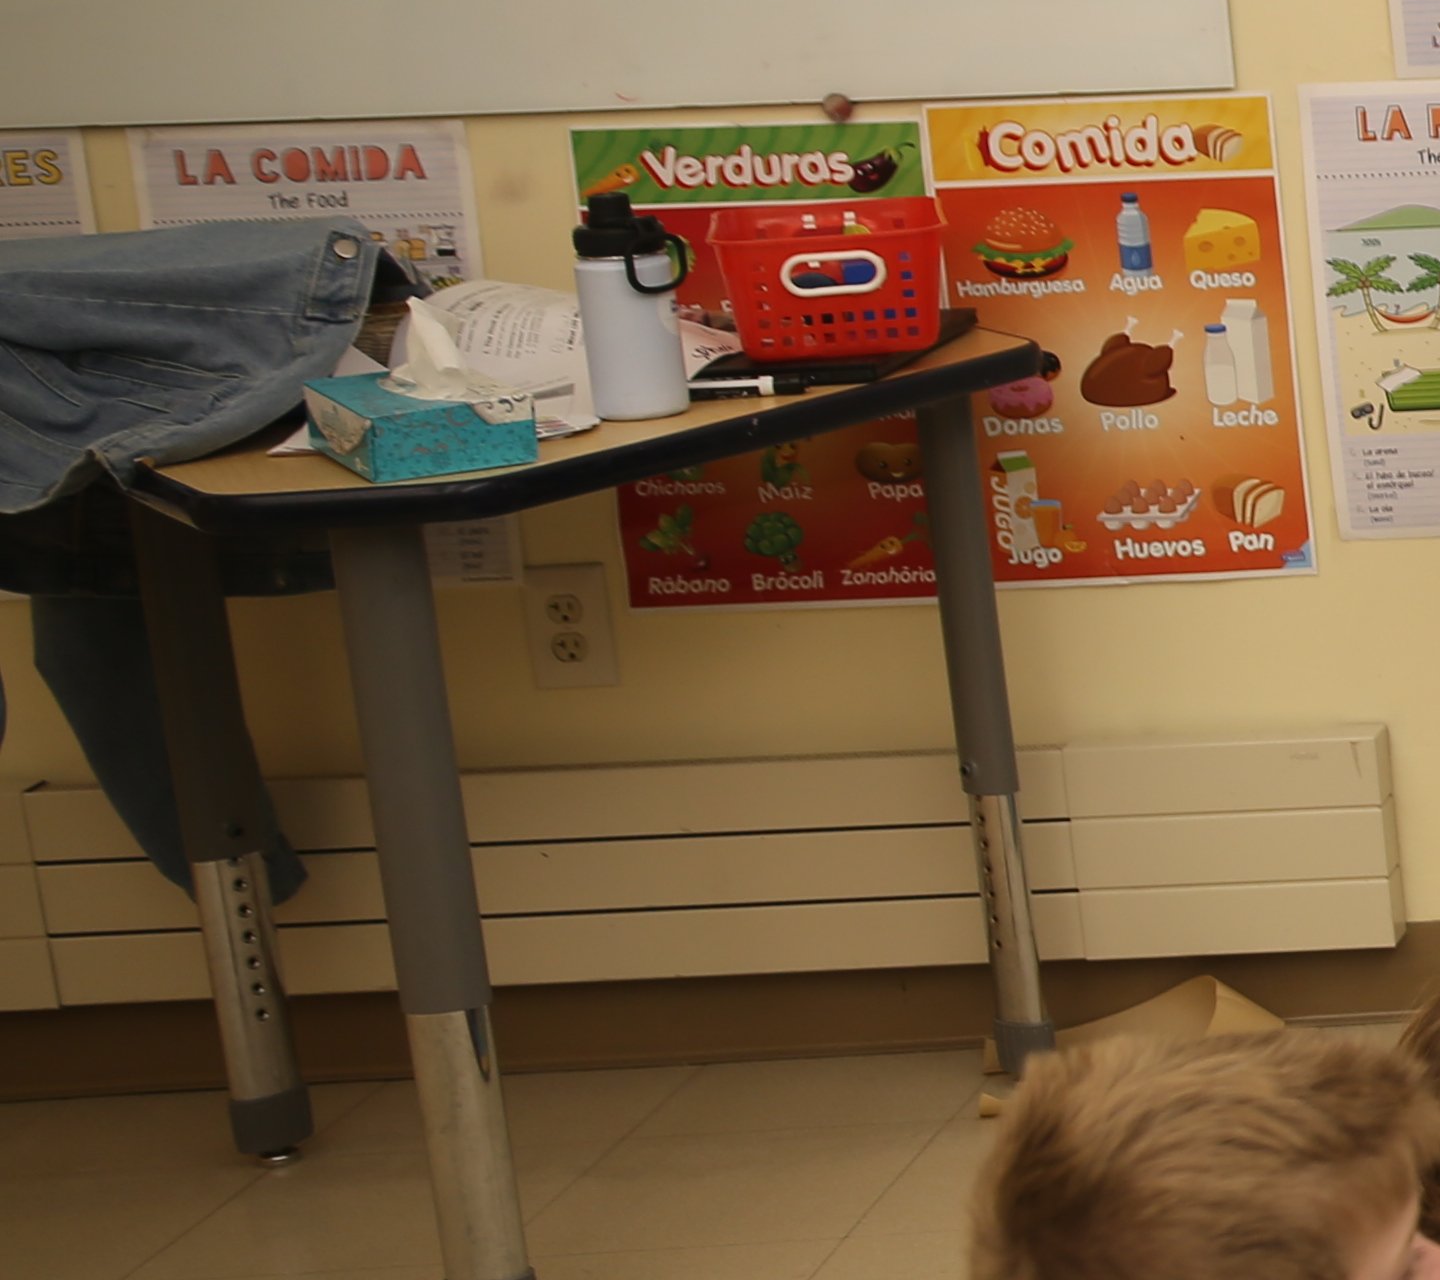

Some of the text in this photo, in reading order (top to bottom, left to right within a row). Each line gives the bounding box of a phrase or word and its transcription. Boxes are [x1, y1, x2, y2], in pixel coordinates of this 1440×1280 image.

[1355, 104, 1413, 142] LA
[984, 114, 1201, 174] Comida
[171, 144, 428, 186] LA COMIDA
[642, 144, 857, 192] Verduras
[267, 190, 350, 210] The Food
[956, 274, 1087, 301] Hamburguesa
[1108, 271, 1164, 296] Agua
[1189, 266, 1257, 293] Queso
[982, 413, 1064, 438] Donas
[1100, 406, 1160, 433] Pollo
[1211, 404, 1280, 429] Leche
[1114, 535, 1207, 562] Huevos
[1228, 528, 1275, 554] Pan
[1008, 544, 1064, 570] Jugo
